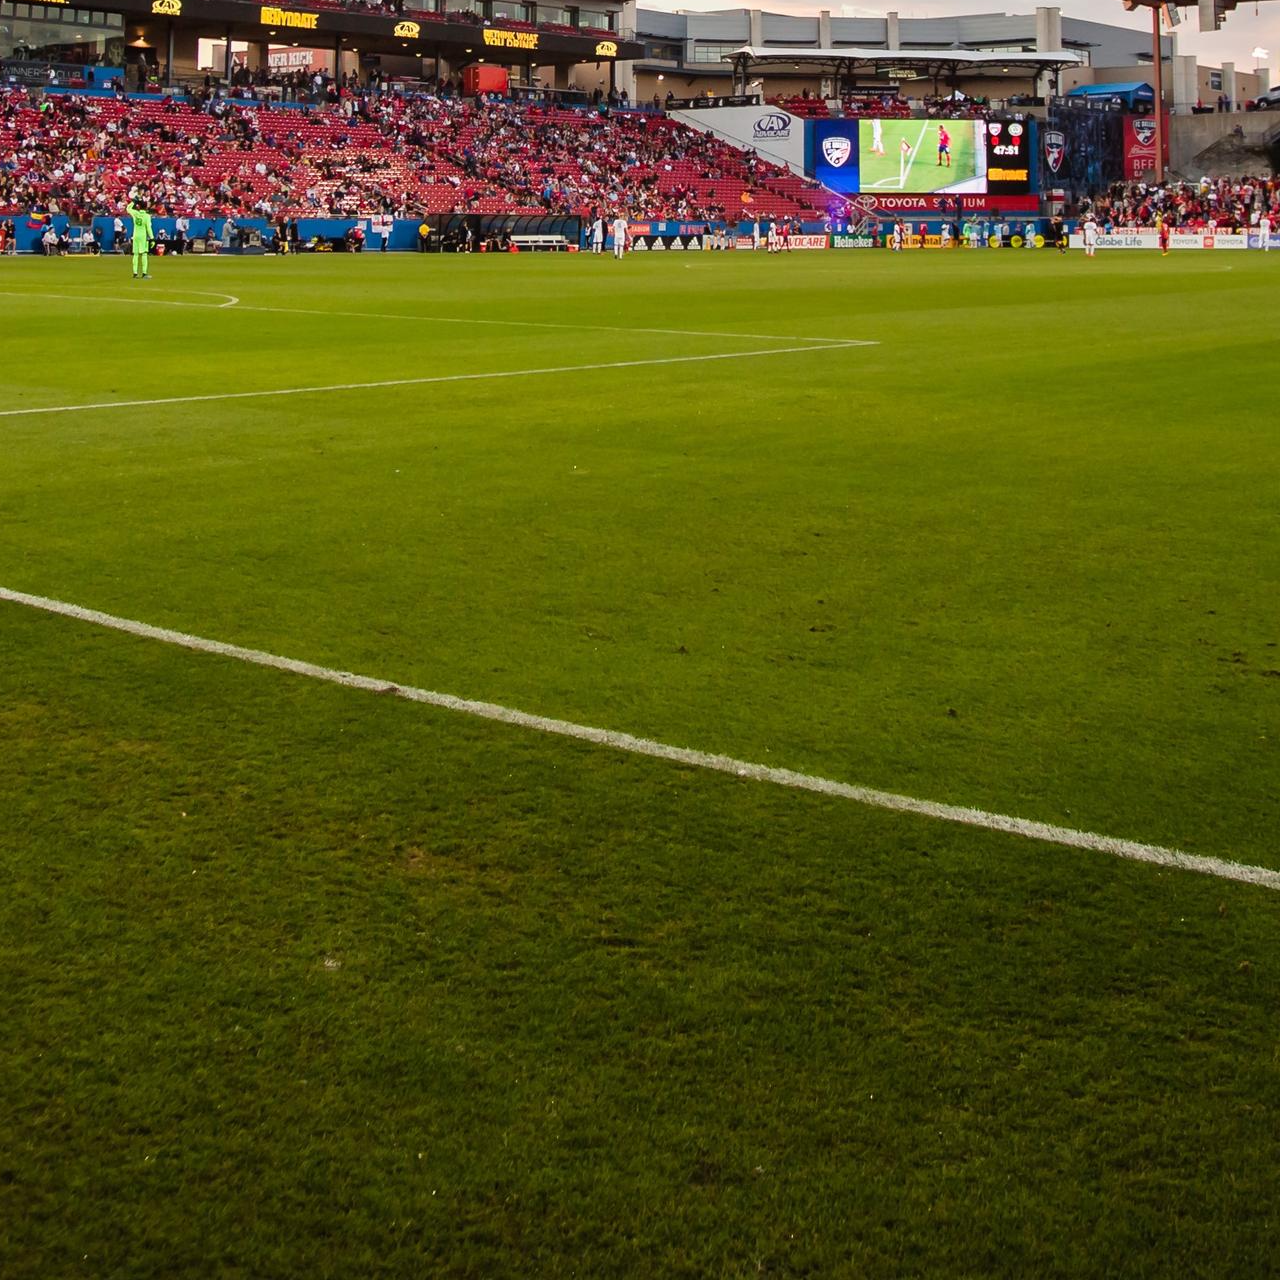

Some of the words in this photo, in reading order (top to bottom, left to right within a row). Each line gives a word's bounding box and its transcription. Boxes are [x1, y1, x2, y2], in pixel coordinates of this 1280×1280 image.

[753, 129, 790, 138] ADVOCARE
[880, 198, 927, 208] TOYOTA
[1095, 236, 1123, 247] Globe
[1125, 236, 1142, 246] Life
